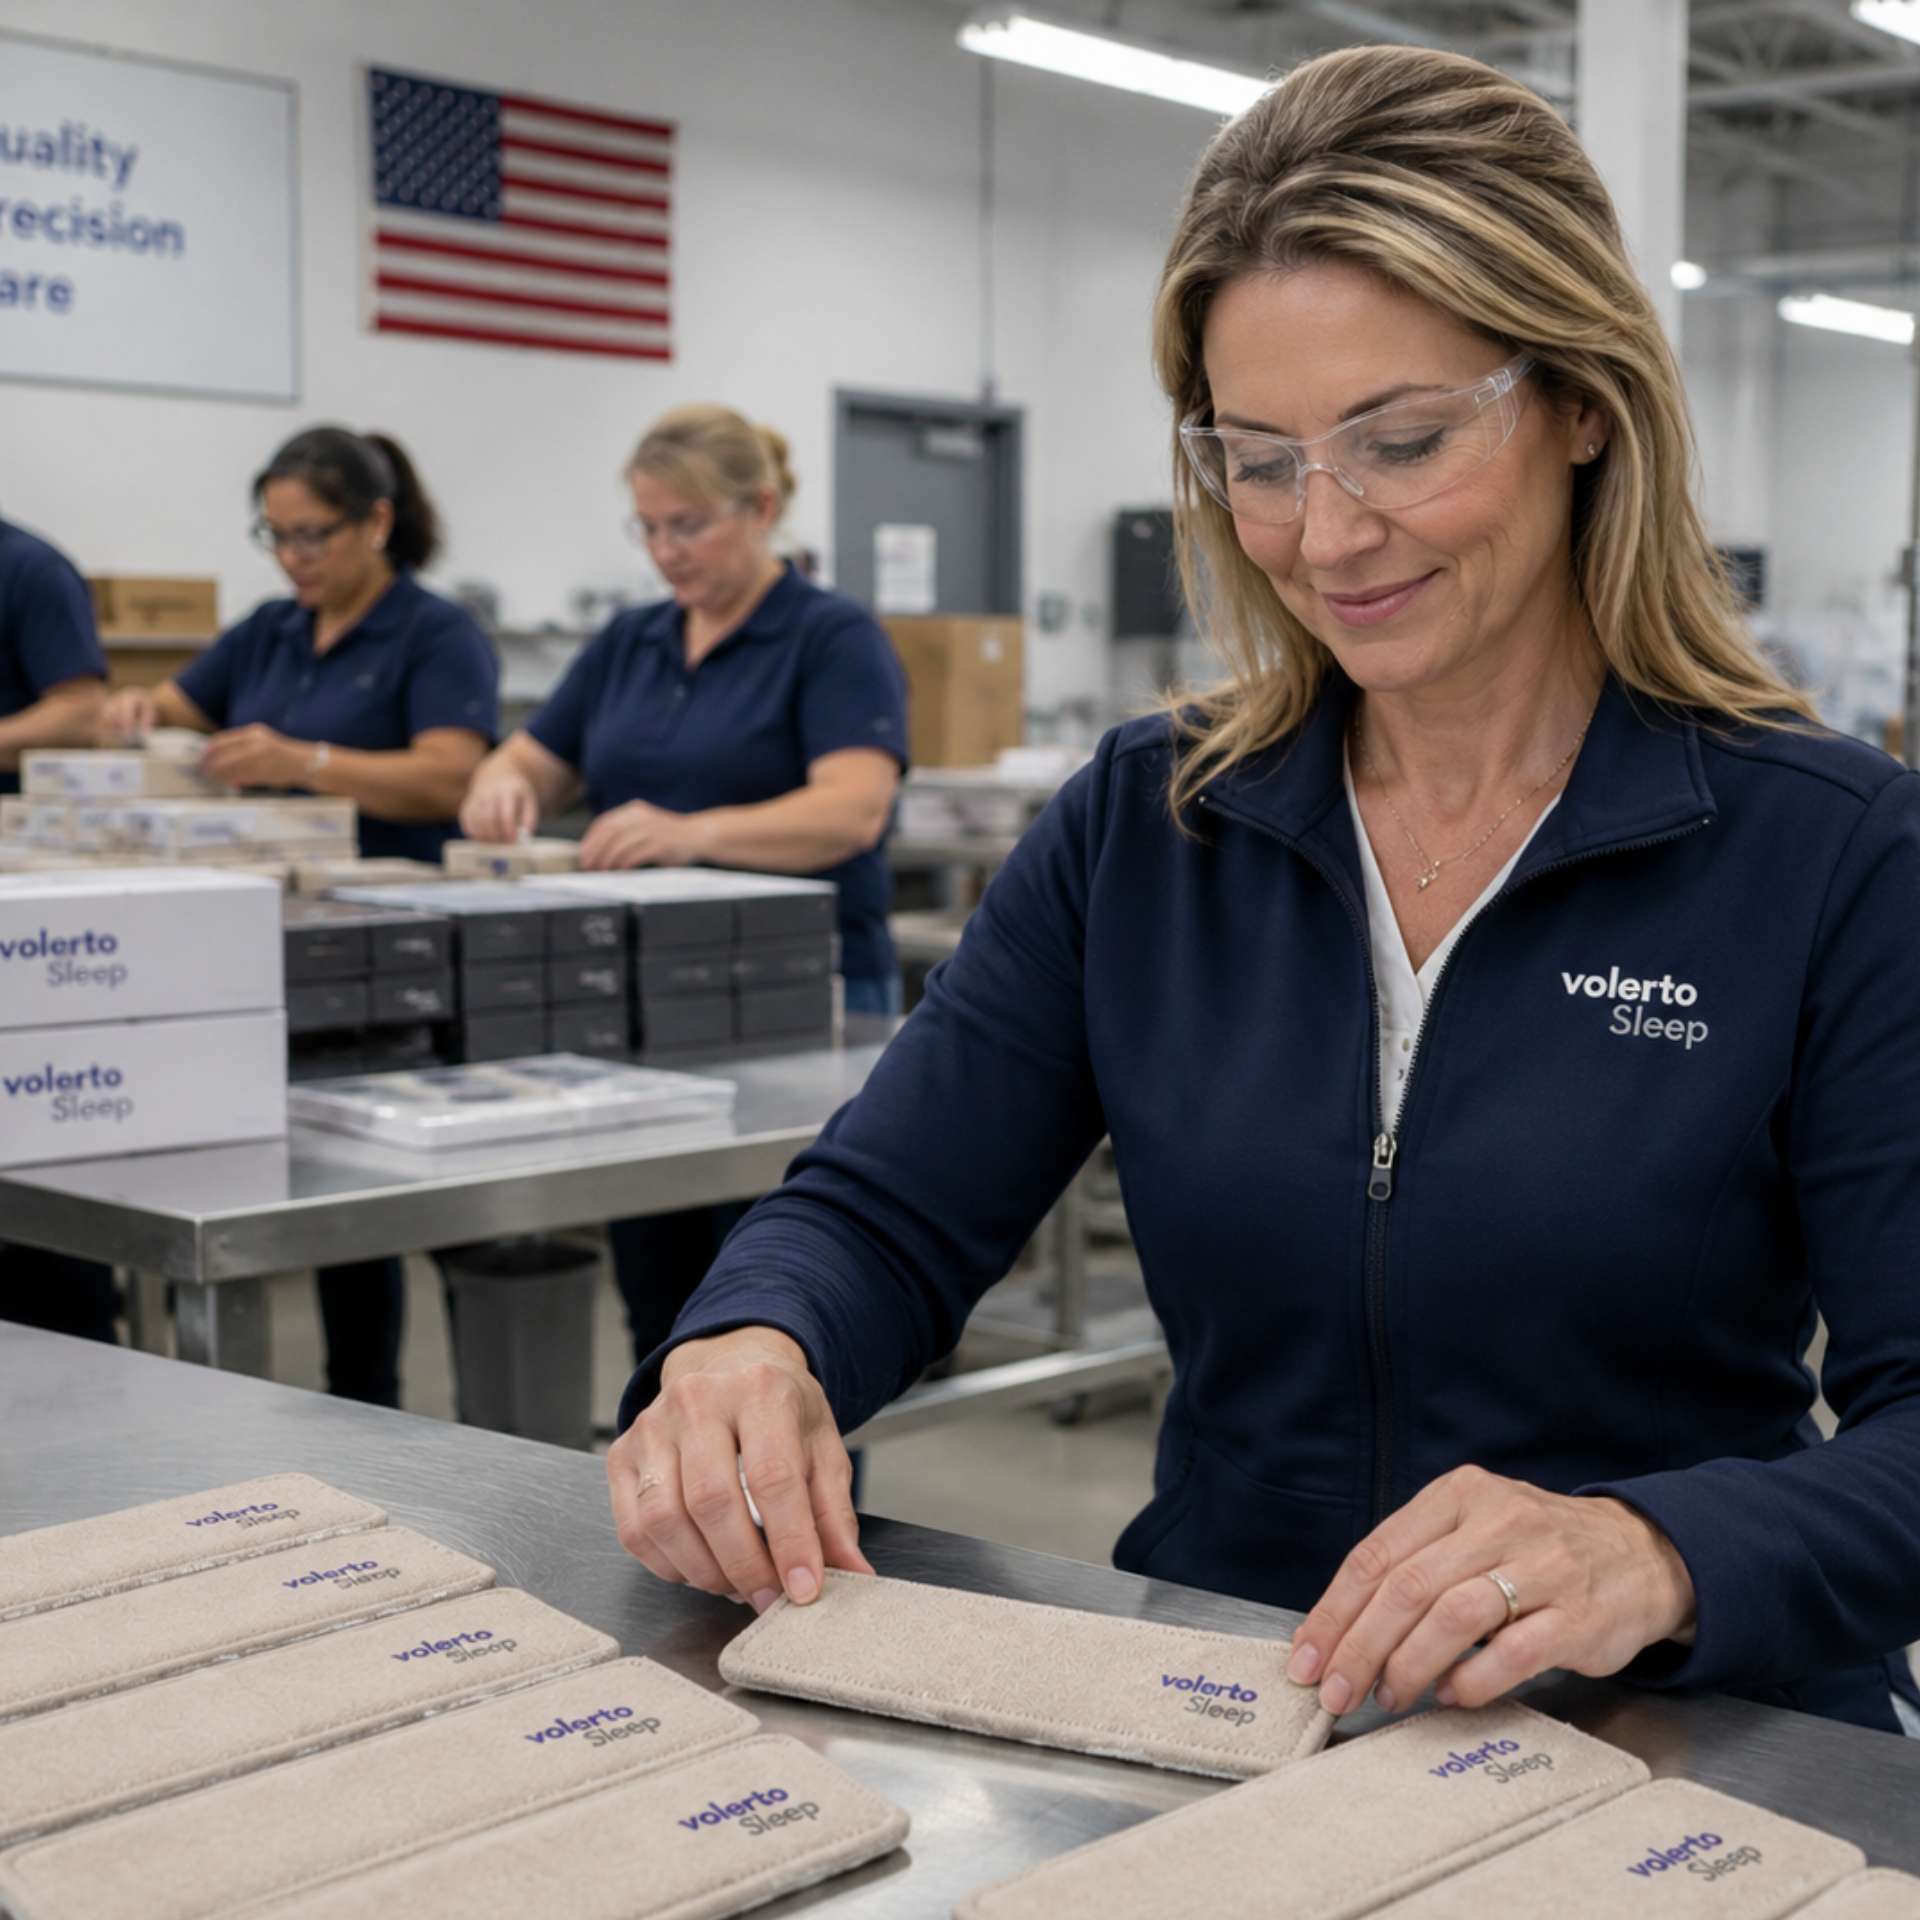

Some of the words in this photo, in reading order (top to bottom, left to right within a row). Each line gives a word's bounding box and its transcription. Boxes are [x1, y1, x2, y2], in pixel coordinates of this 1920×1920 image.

[0, 119, 138, 190] uality
[0, 926, 118, 960] volerto
[47, 960, 128, 990] Sleep
[1561, 966, 1698, 1007] volerto
[1609, 1004, 1709, 1050] Sleep
[3, 1062, 123, 1095] volerto
[51, 1095, 134, 1124] Sleep
[185, 1503, 279, 1527] volerto
[235, 1508, 301, 1529] Sleep
[282, 1560, 378, 1589] volerto
[332, 1567, 401, 1590] Sleep
[391, 1630, 493, 1661] volerto
[446, 1639, 517, 1663] Sleep
[1161, 1674, 1258, 1702] volerto
[524, 1706, 633, 1744] volerto
[1183, 1695, 1256, 1727] Sleep
[583, 1717, 661, 1748] Sleep
[1428, 1740, 1519, 1778] volerto
[1483, 1753, 1555, 1783] Sleep
[678, 1788, 788, 1831] volerto
[739, 1801, 820, 1836] Sleep
[1627, 1832, 1723, 1878] volerto
[1687, 1846, 1763, 1882] Sleep
